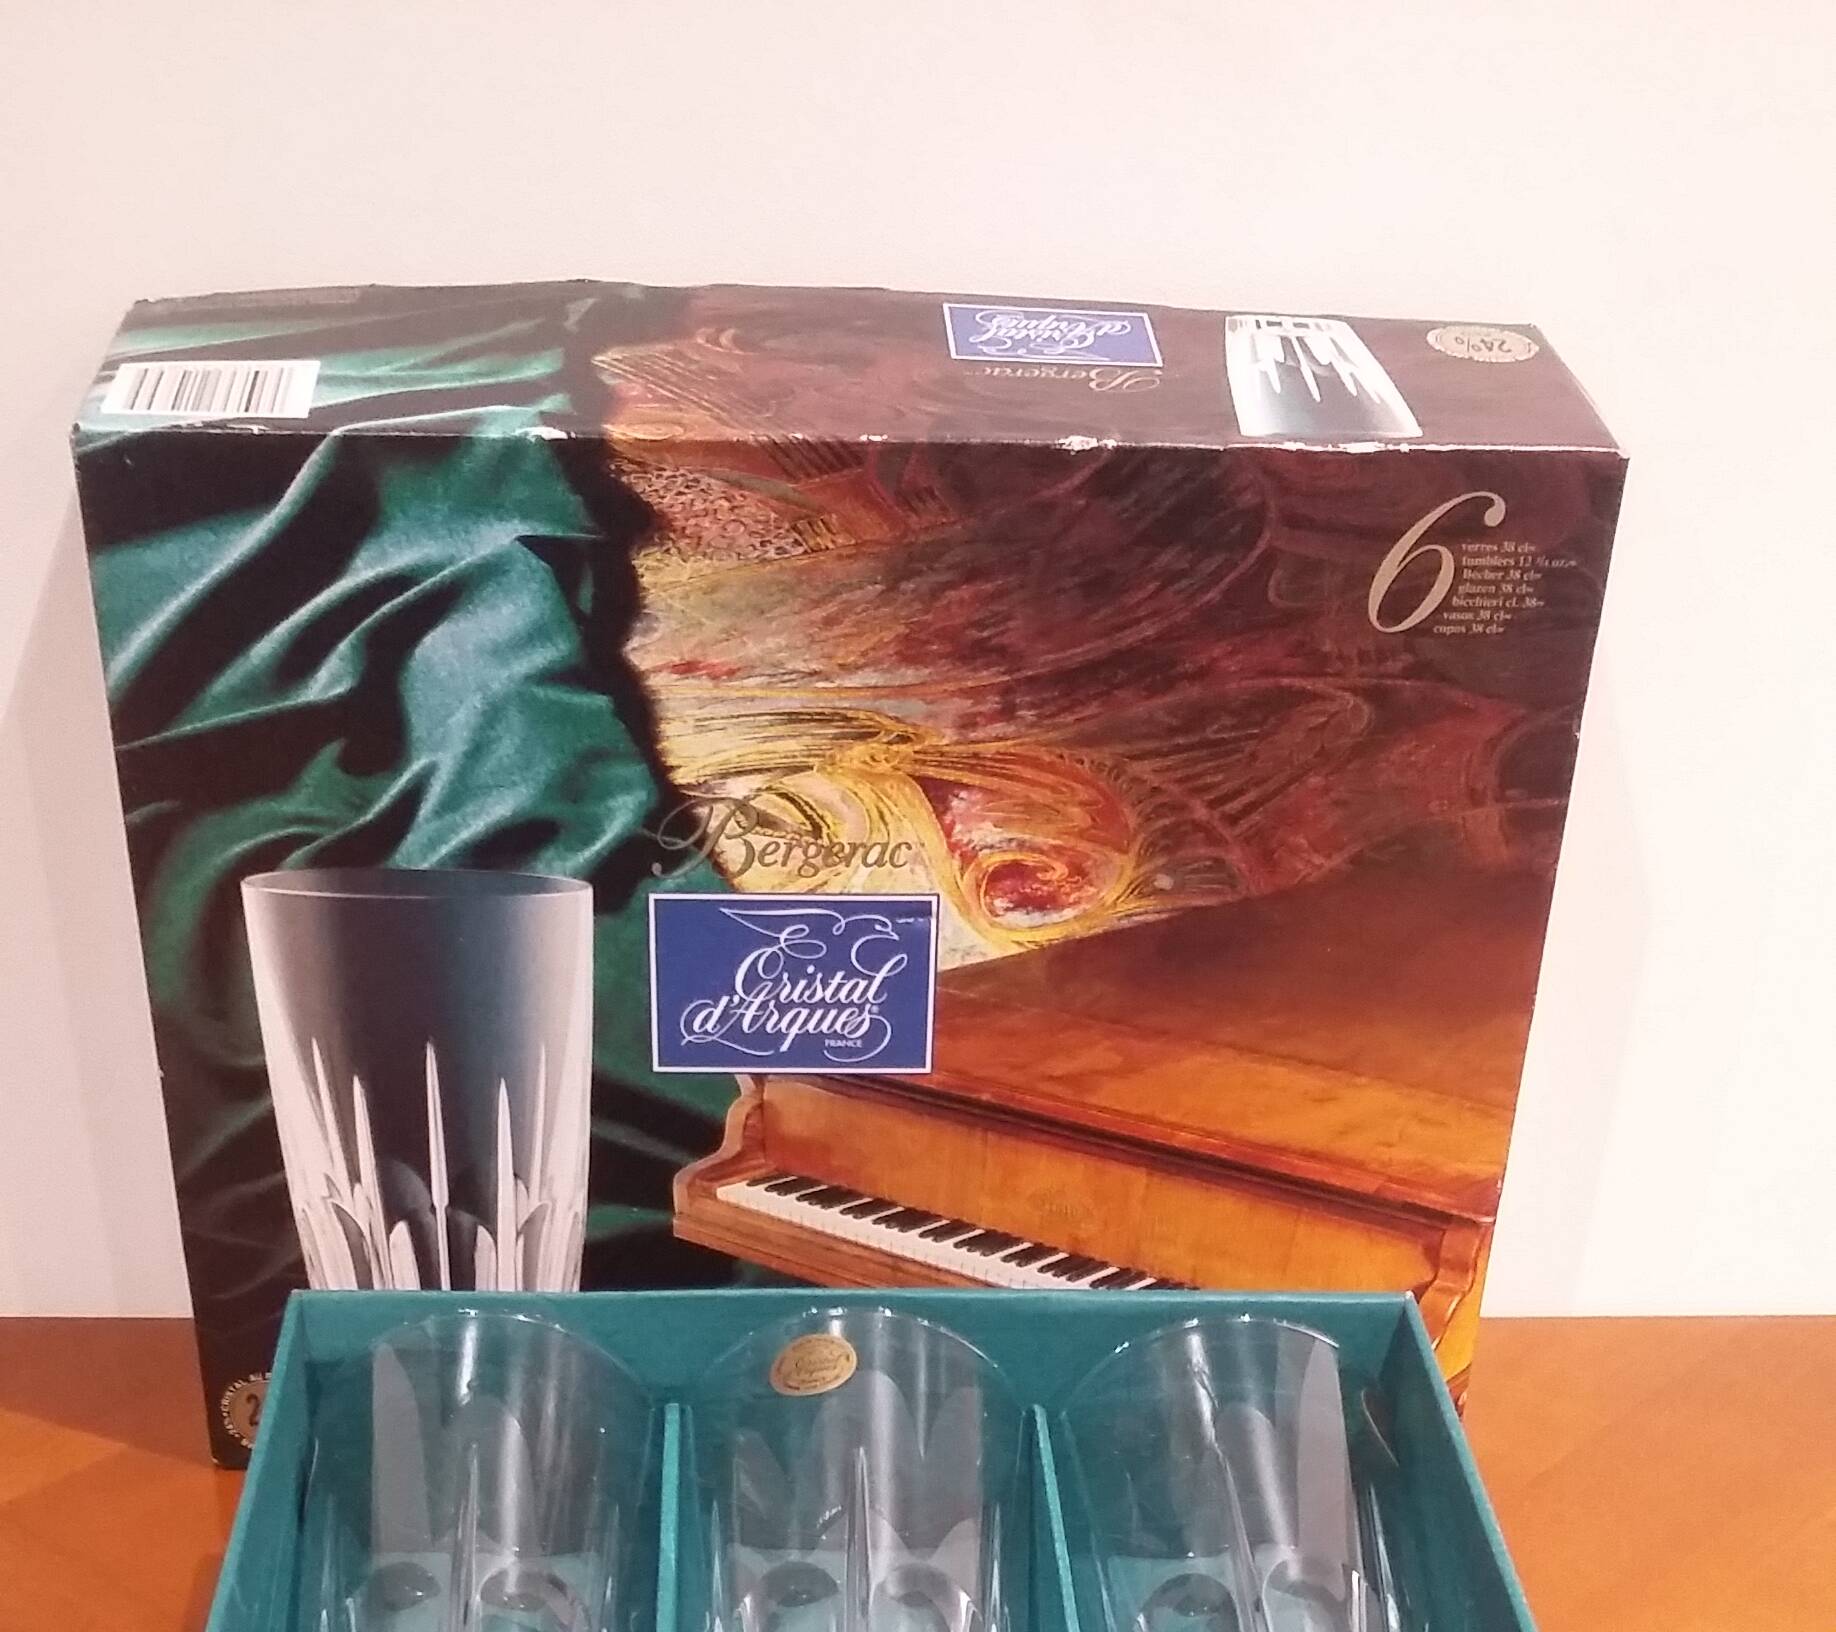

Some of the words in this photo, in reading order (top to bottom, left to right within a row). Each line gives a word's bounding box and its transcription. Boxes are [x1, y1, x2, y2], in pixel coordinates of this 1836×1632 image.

[1454, 336, 1512, 353] 24%
[984, 366, 1163, 392] Bergerac
[1501, 541, 1516, 552] 38
[1368, 491, 1506, 633] 6
[1519, 555, 1531, 567] 12
[1508, 568, 1521, 580] 38
[1500, 583, 1513, 594] 38
[1476, 610, 1491, 621] 38
[1468, 623, 1484, 634] 38
[651, 797, 913, 879] Bergerac
[735, 945, 908, 1004] Cristal
[824, 1038, 864, 1048] FRANCE
